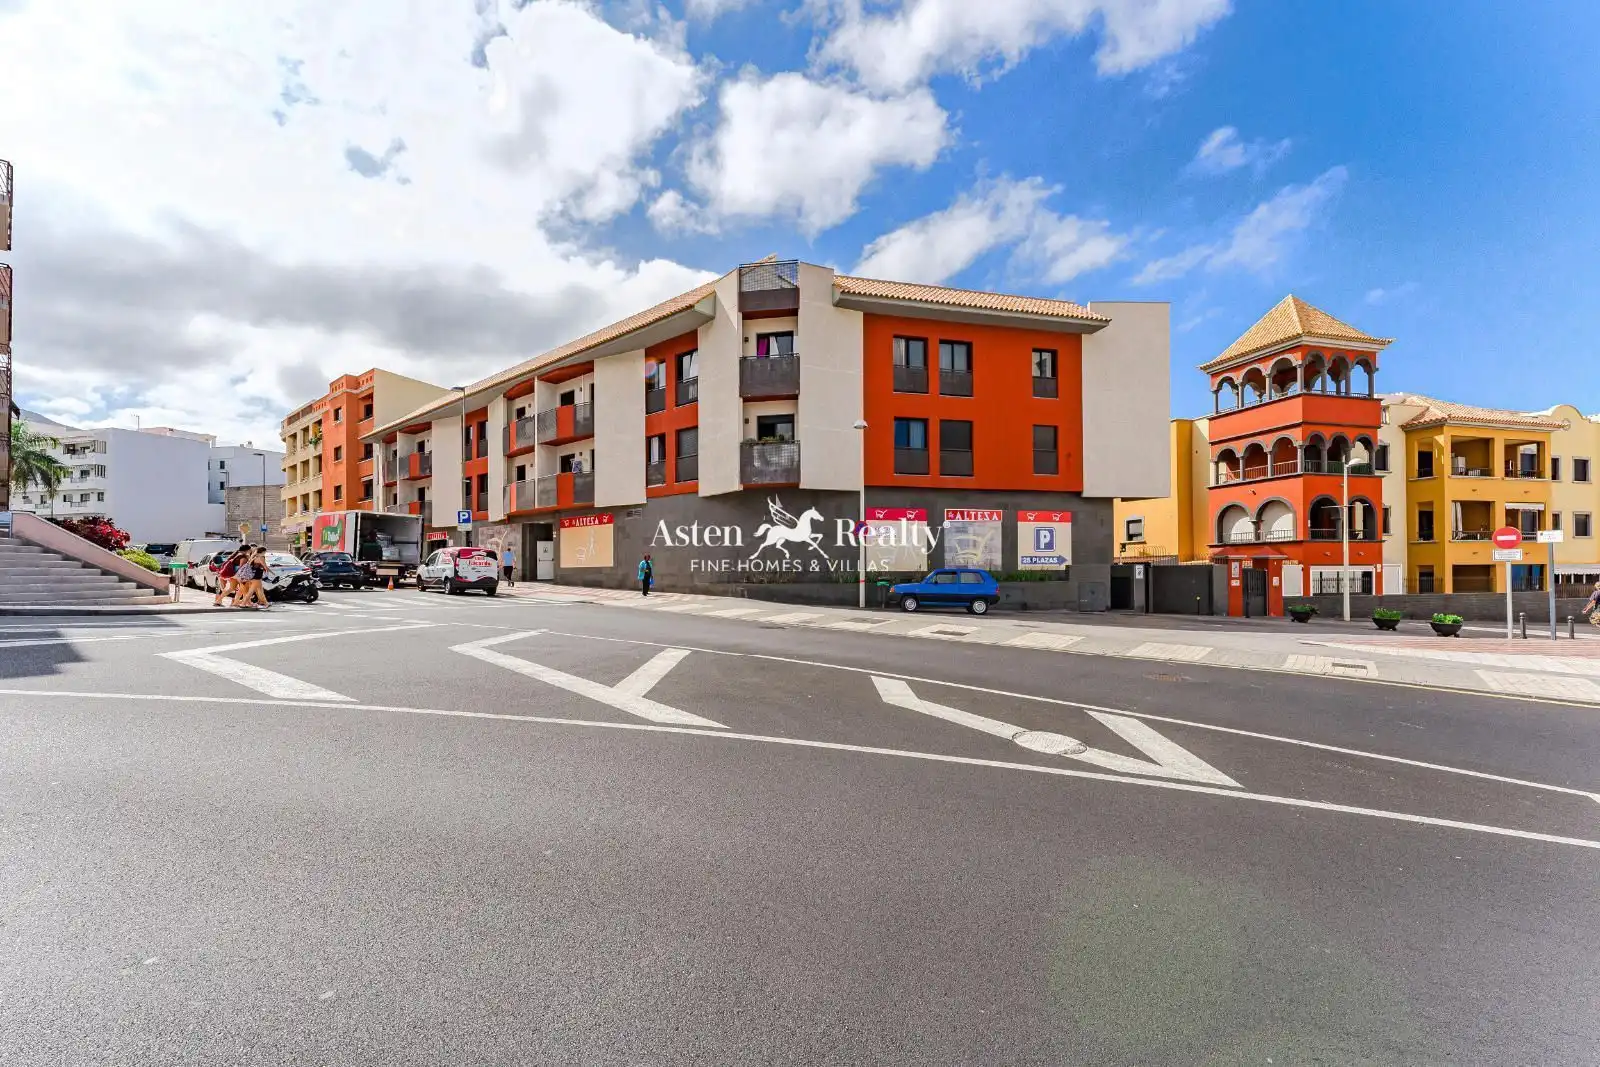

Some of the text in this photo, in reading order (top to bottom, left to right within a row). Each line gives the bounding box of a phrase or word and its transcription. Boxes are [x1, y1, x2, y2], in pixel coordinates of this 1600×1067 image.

[955, 511, 999, 521] ALTESA
[575, 517, 599, 527] ALTESA
[1039, 530, 1051, 549] P
